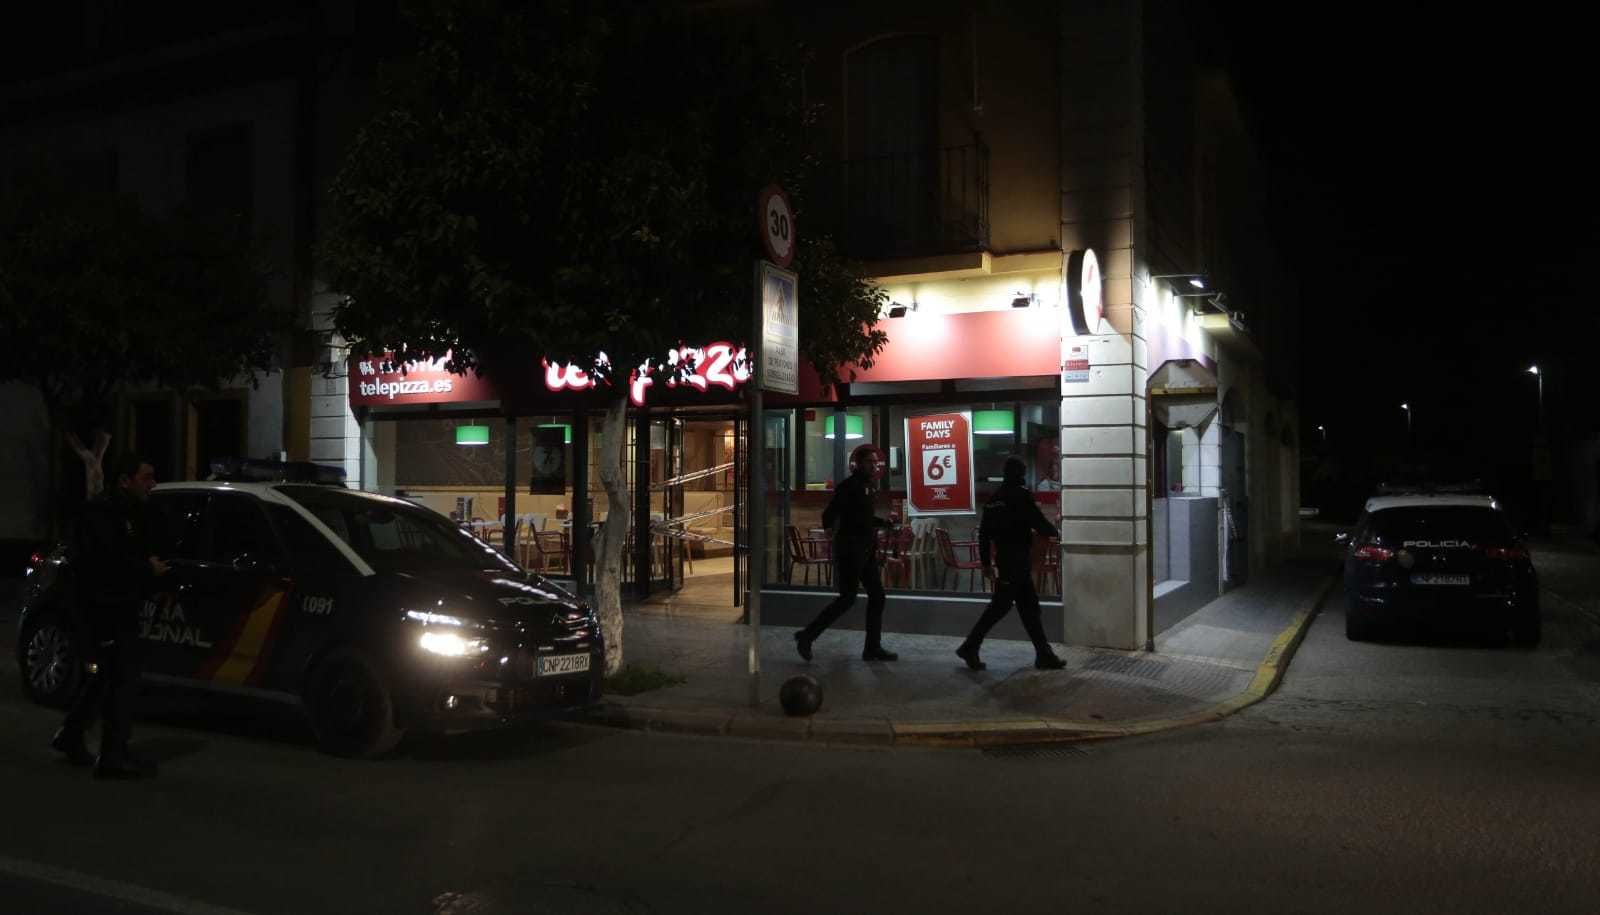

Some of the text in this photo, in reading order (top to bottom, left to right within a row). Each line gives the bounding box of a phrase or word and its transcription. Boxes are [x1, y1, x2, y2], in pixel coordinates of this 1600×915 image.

[771, 210, 788, 241] 30
[360, 377, 452, 399] telepizza.es
[921, 420, 954, 430] FAMILY
[926, 429, 950, 439] DAYS
